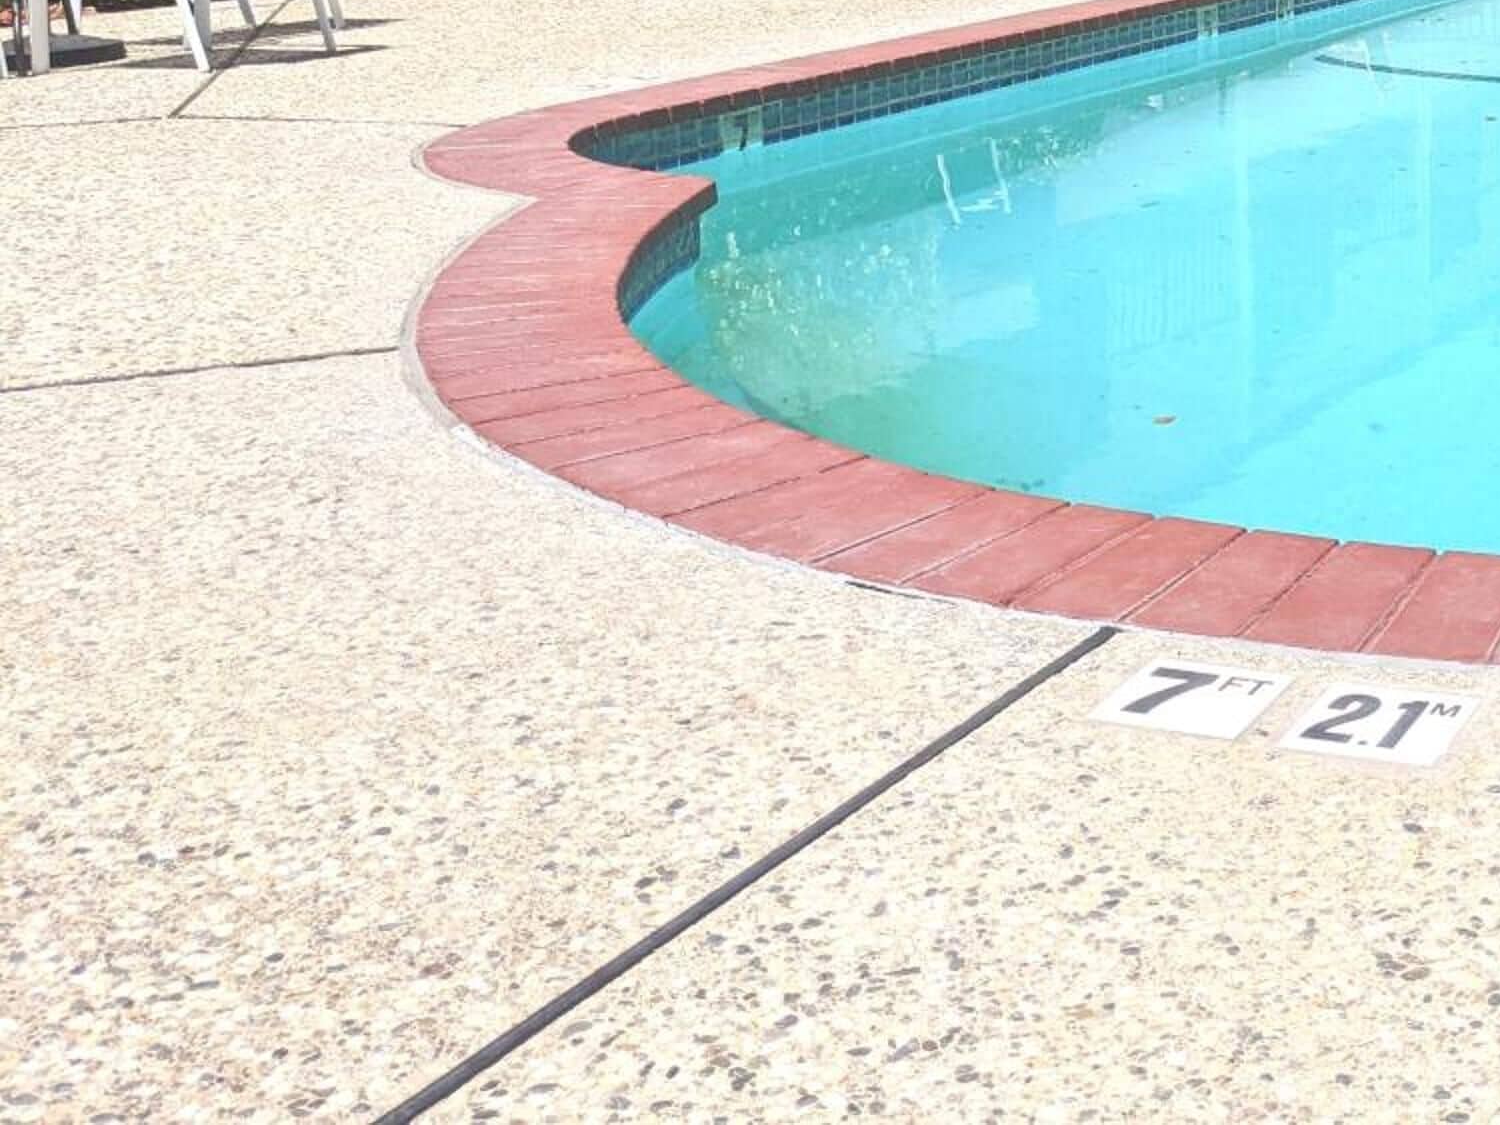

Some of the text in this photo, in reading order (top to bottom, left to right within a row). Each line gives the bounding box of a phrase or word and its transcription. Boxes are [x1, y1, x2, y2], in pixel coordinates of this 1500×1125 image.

[1120, 667, 1274, 715] 7 FT
[1300, 693, 1429, 751] 2.1
